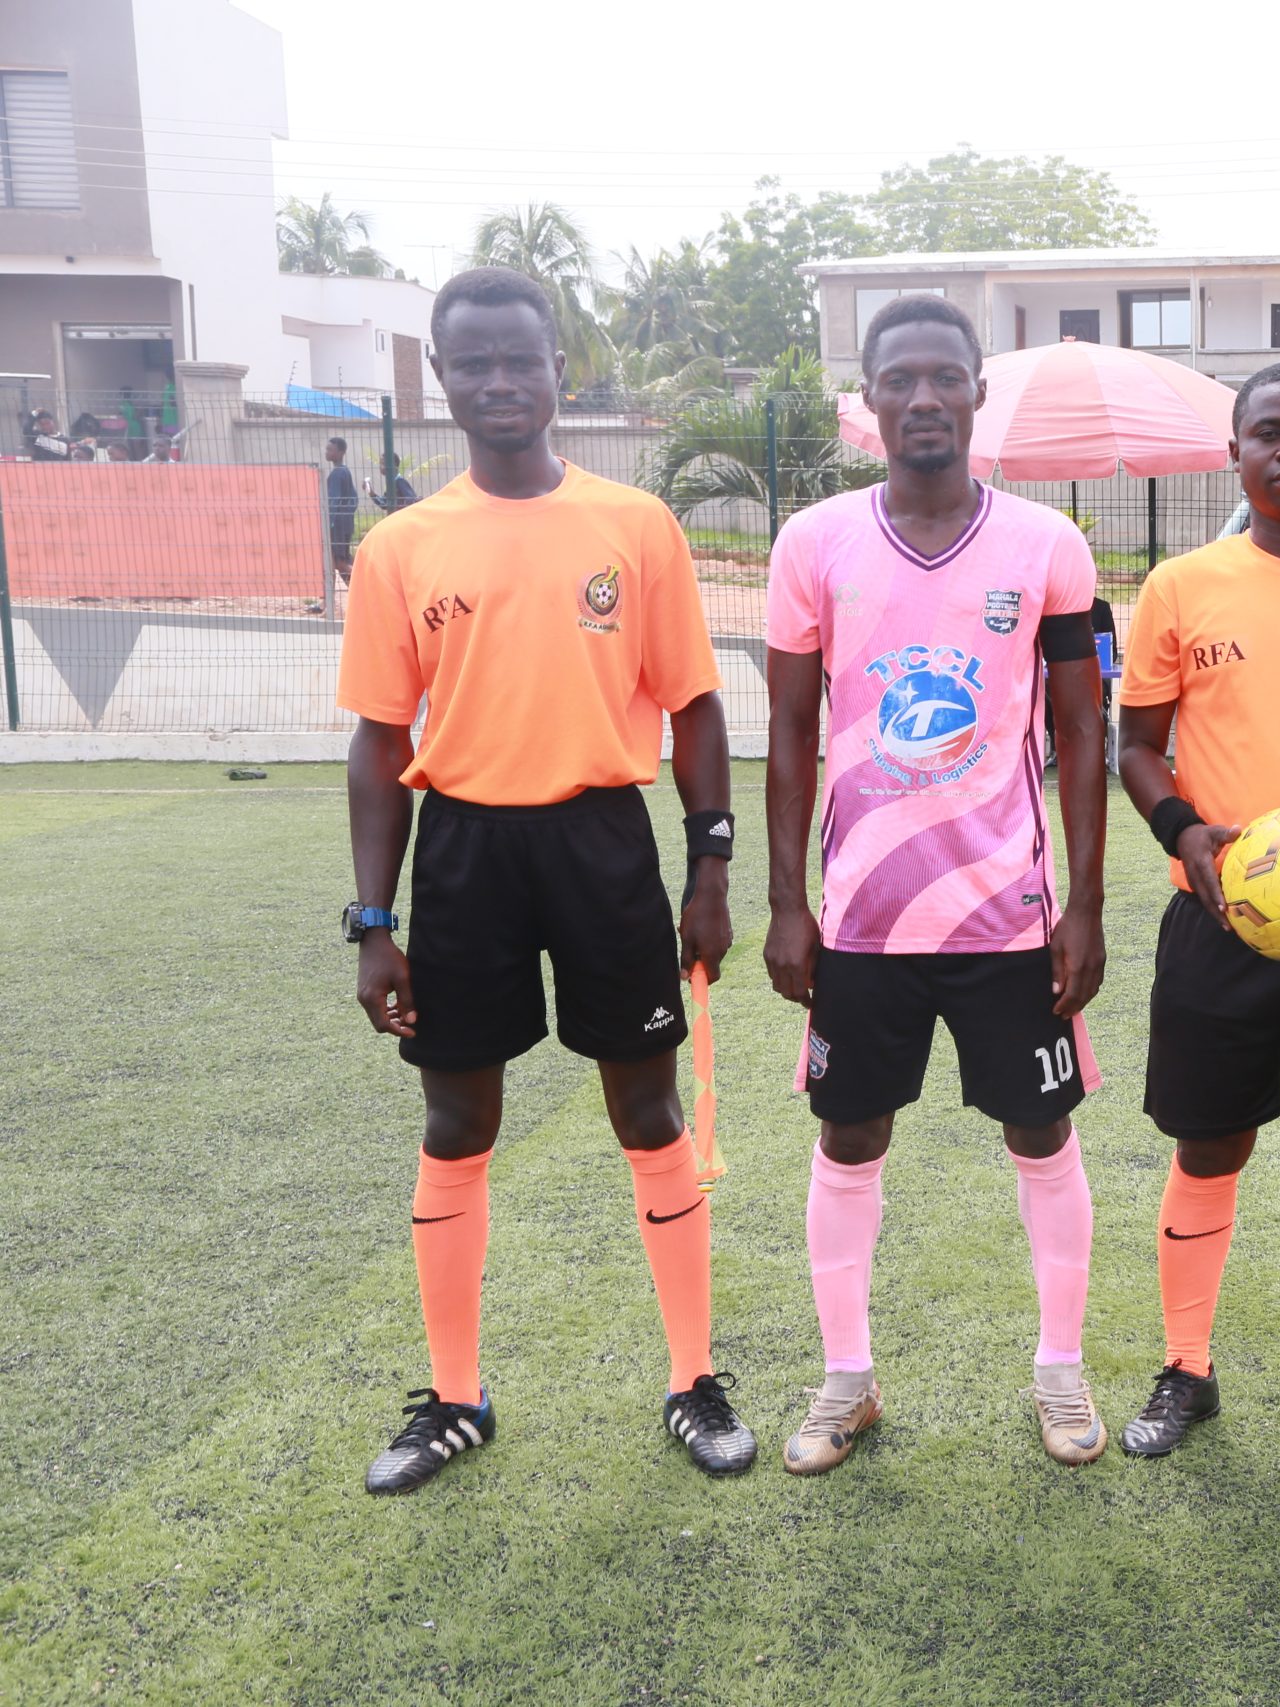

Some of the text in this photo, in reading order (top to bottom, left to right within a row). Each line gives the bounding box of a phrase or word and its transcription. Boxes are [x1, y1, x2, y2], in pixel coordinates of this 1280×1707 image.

[422, 593, 474, 634] RFA
[986, 602, 1019, 610] FOOTLL
[864, 644, 985, 693] TCCL
[1192, 640, 1247, 671] RFA
[931, 742, 988, 784] Logistics
[644, 1014, 675, 1032] Kappa
[1034, 1036, 1074, 1094] 10
